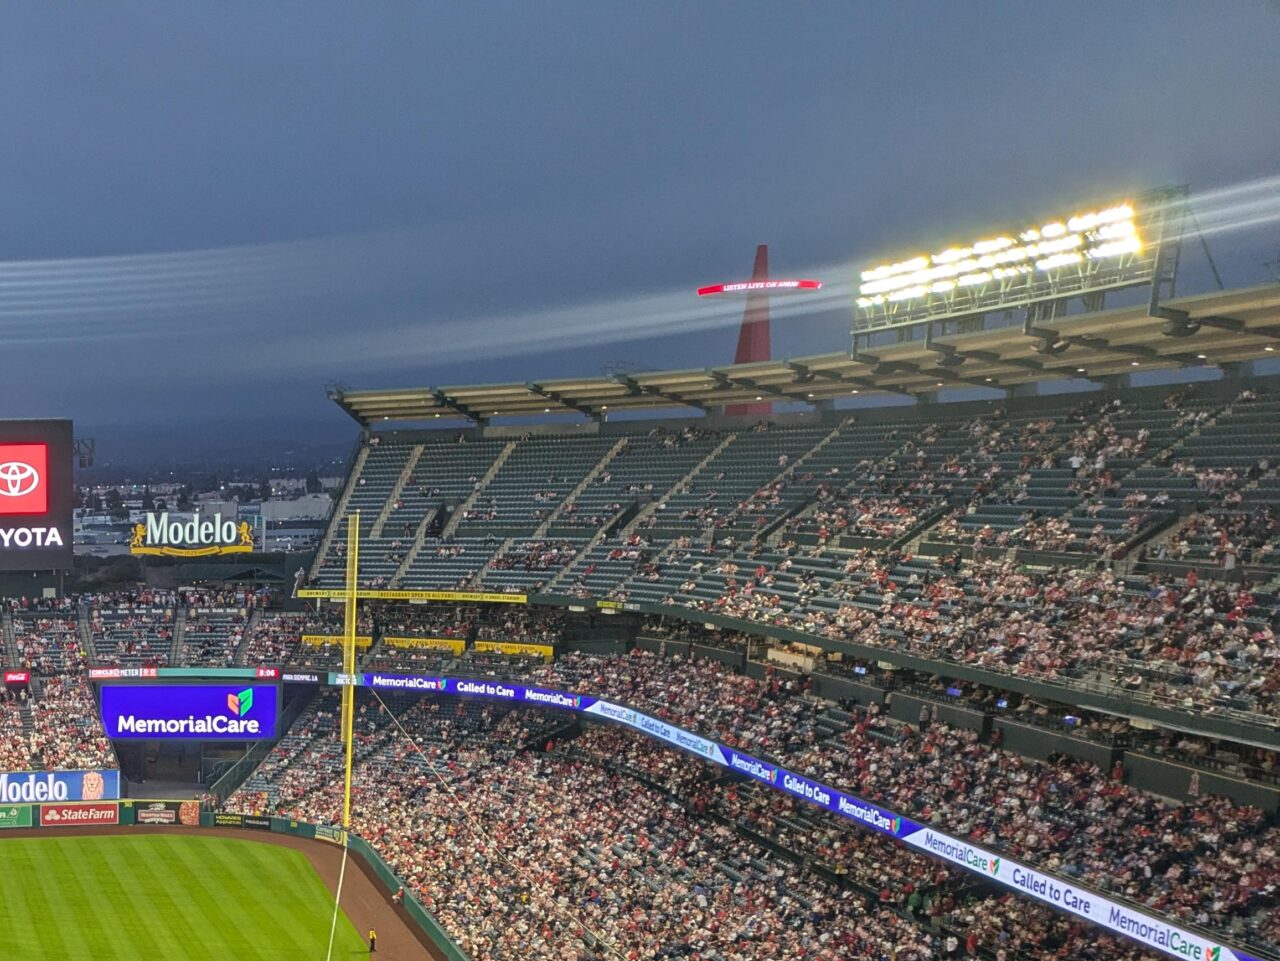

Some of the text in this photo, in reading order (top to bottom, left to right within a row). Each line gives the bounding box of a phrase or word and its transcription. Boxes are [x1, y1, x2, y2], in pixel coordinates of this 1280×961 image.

[723, 283, 747, 291] LISTEN
[146, 511, 237, 545] Modelo
[259, 669, 275, 677] 8:06
[117, 715, 260, 734] MemorialCare
[373, 676, 436, 689] MemorialCare
[457, 681, 485, 694] Called
[487, 684, 495, 695] to
[496, 685, 515, 697] Care
[525, 689, 573, 707] MemorialCare
[732, 754, 770, 781] MemorialCare
[783, 775, 805, 795] Called
[805, 785, 813, 798] to
[813, 786, 830, 805] Care
[838, 797, 891, 830] MemorialCare
[924, 831, 988, 871] MemorialCare
[1012, 868, 1046, 895] Called
[1049, 885, 1061, 901] to
[1063, 889, 1091, 914] Care
[1109, 906, 1202, 960] MemorialCare
